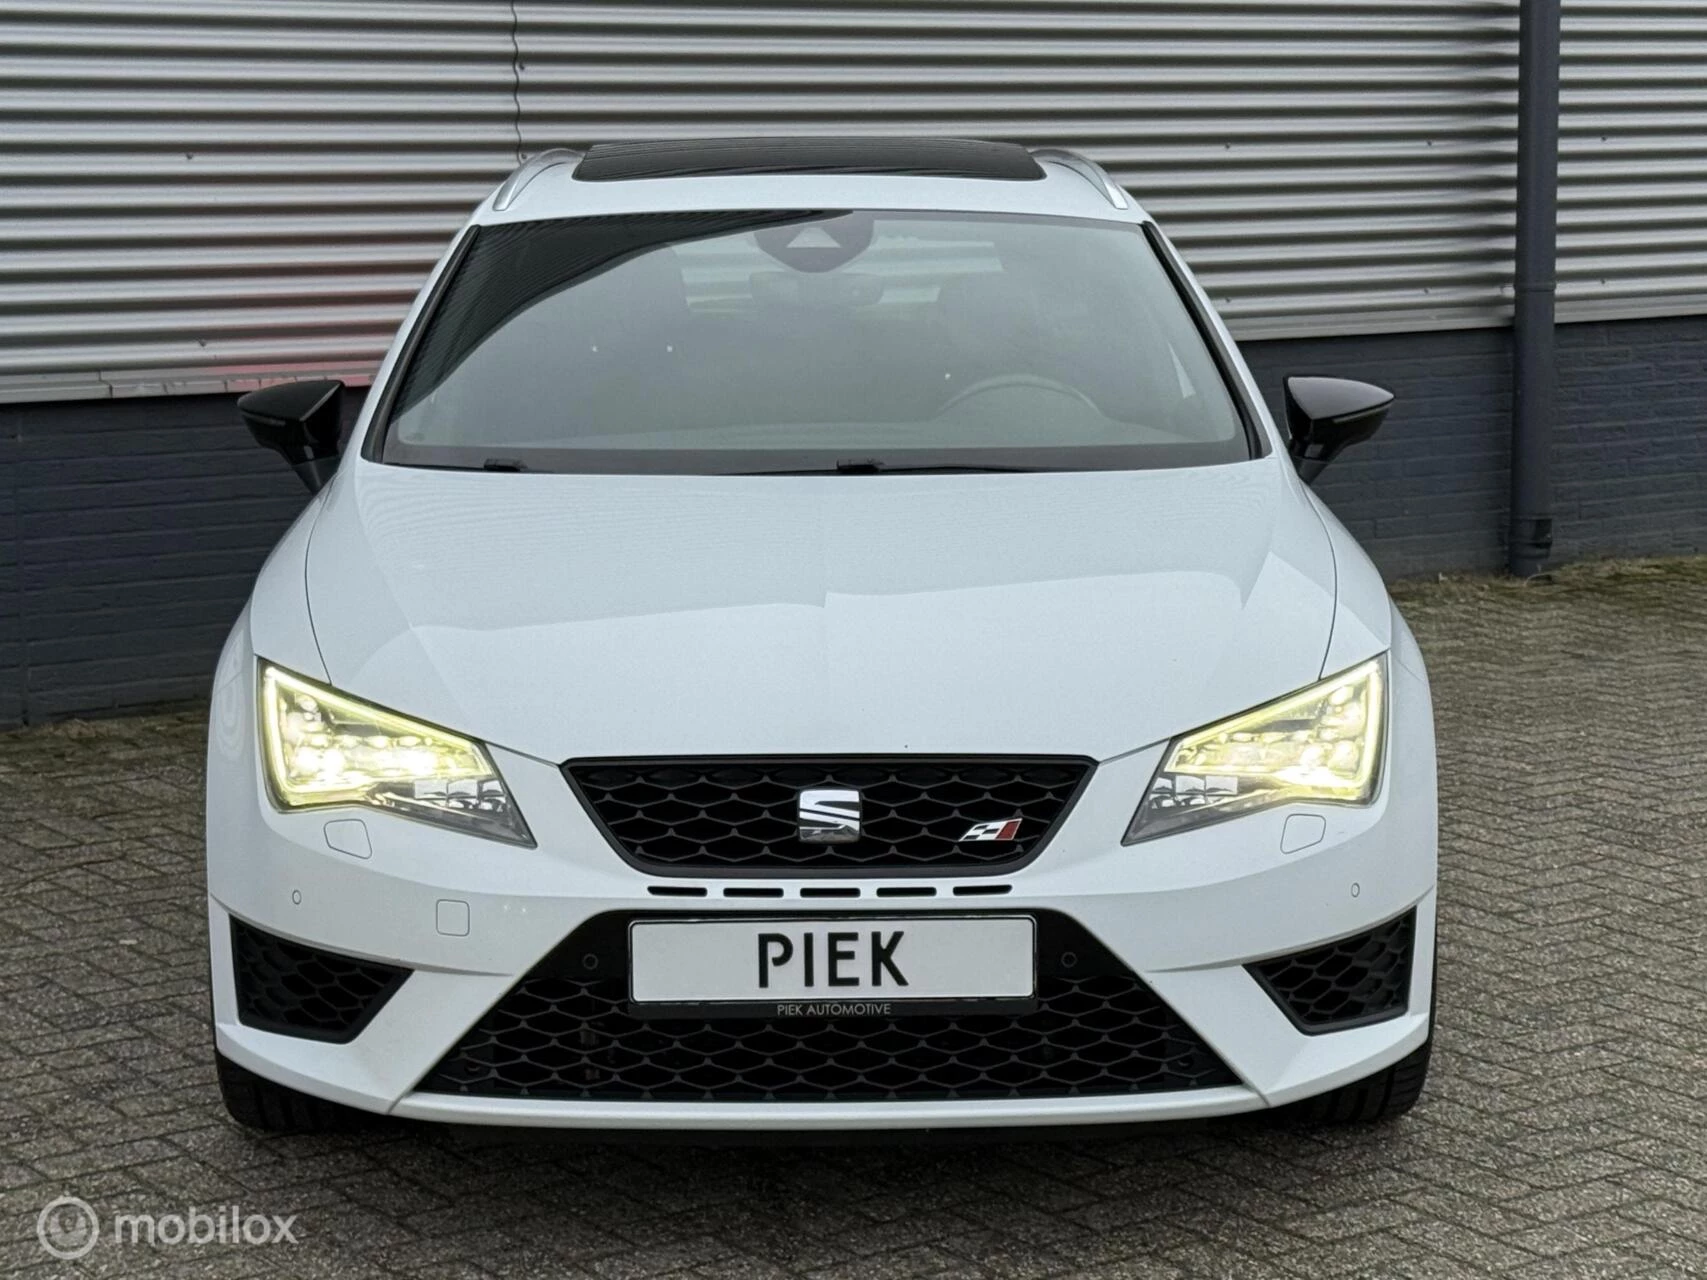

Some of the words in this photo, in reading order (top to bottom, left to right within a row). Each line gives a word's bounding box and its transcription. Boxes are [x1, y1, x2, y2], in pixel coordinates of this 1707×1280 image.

[758, 931, 909, 988] PIEK
[777, 1004, 803, 1016] PIEK
[806, 1003, 891, 1016] AUTOMOTIVE
